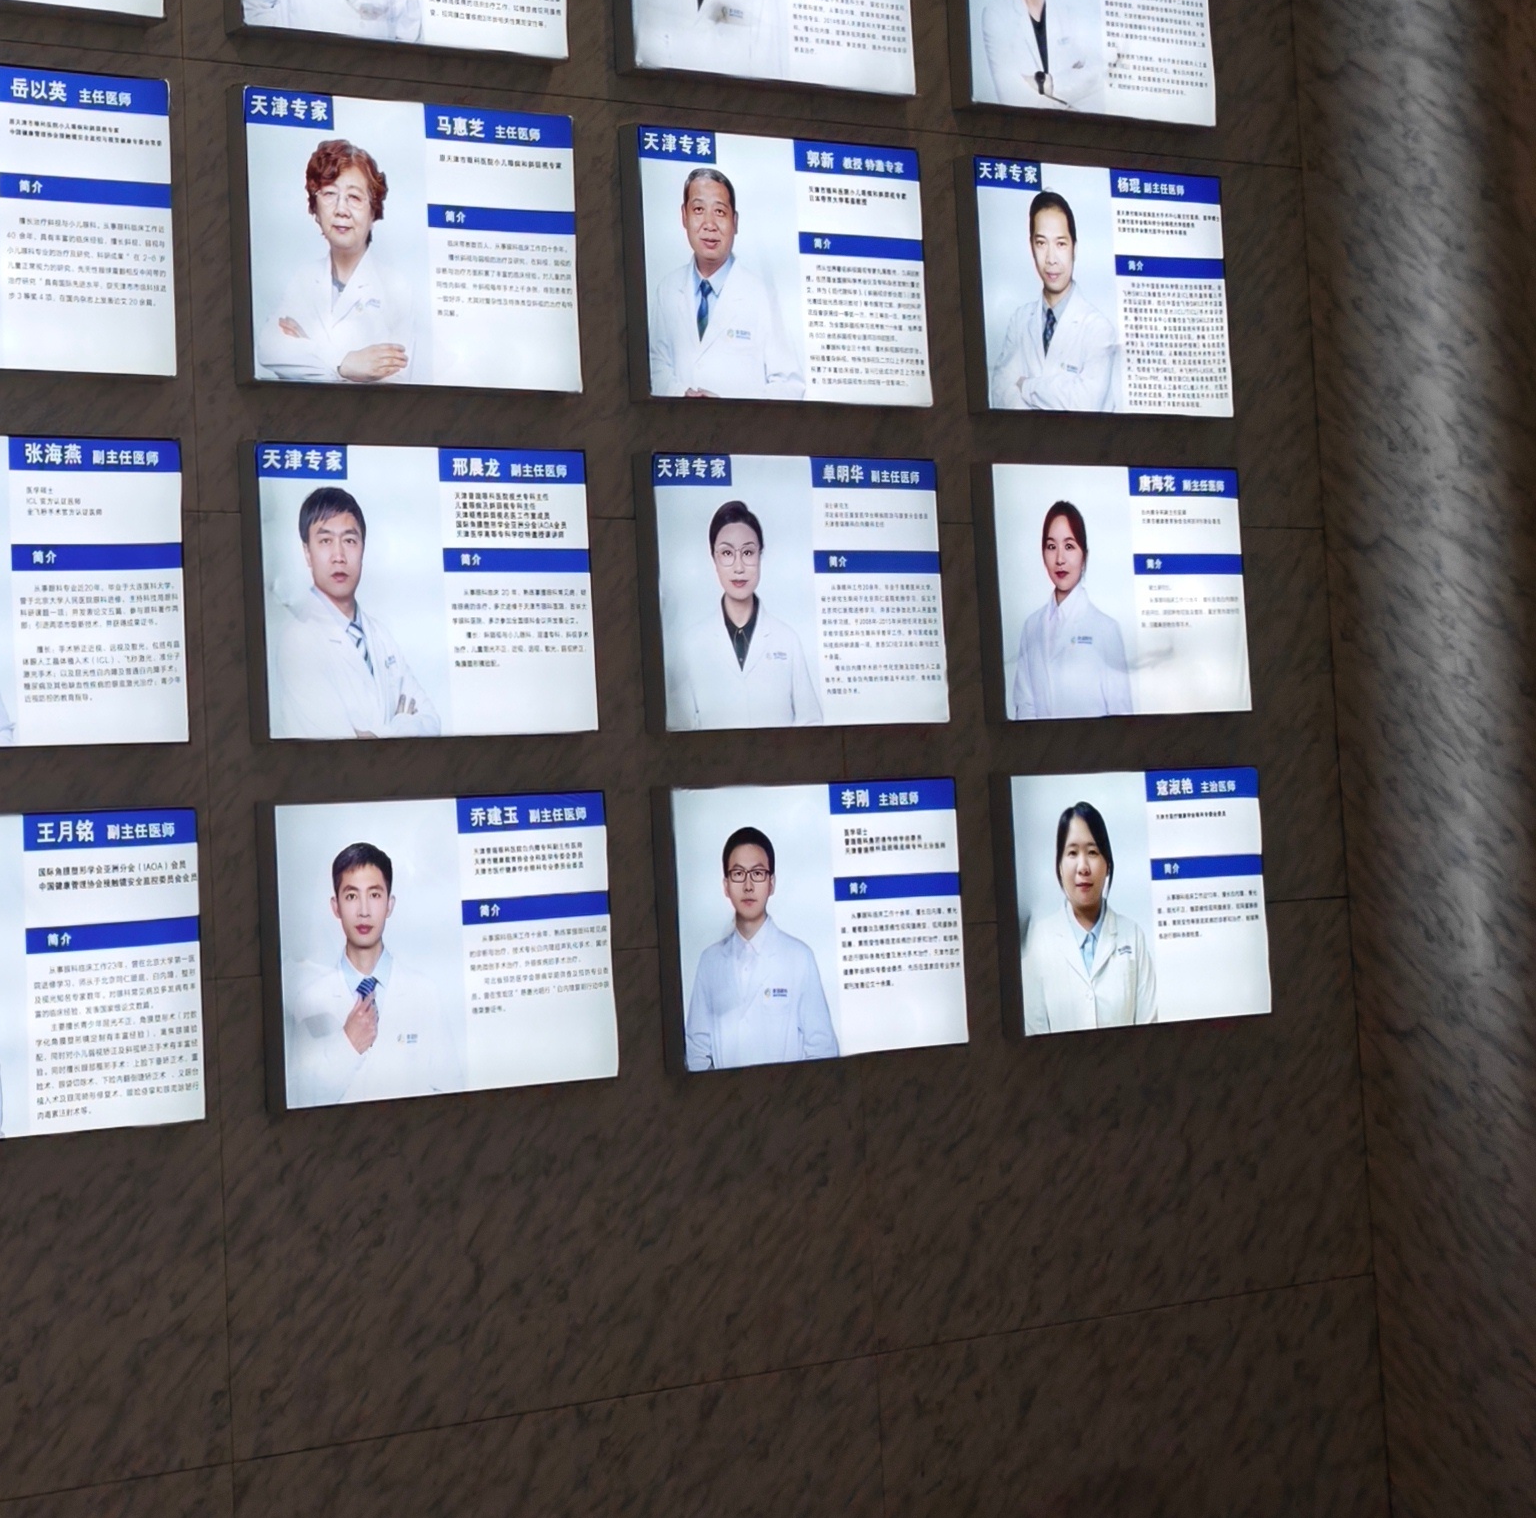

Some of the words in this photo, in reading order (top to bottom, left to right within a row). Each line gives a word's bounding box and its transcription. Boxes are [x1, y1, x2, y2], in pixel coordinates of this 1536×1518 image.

[9, 76, 67, 102] 岳以英
[78, 87, 132, 107] 主任医师
[250, 94, 328, 122] 天津专家
[436, 115, 485, 138] 马惠芝
[494, 124, 541, 142] 主任医师
[644, 133, 711, 156] 天津专家
[805, 149, 834, 169] 郭新
[842, 156, 863, 171] 教授
[979, 163, 1037, 184] 天津专家
[18, 178, 43, 194] 简介
[1143, 181, 1185, 196] 副主任医师
[444, 209, 466, 224] 简介
[813, 237, 831, 249] 简介
[1127, 259, 1144, 271] 简介
[24, 441, 82, 465] 张海燕
[91, 448, 159, 466] 副主任医师
[262, 449, 342, 472] 天津专家
[451, 457, 501, 477] 邢晨龙
[509, 463, 567, 478] 副主任医师
[658, 458, 726, 478] 天津专家
[821, 464, 865, 484] 单明华
[870, 469, 920, 484] 副主任医师
[31, 549, 57, 564] 简介
[460, 552, 482, 566] 简介
[828, 555, 847, 568] 简介
[1145, 558, 1162, 569] 简介
[1200, 779, 1236, 793] 主治医师
[840, 788, 870, 809] 李刚
[878, 790, 919, 807] 主治医师
[469, 805, 520, 827] 乔建玉
[528, 806, 587, 824] 副主任医师
[36, 818, 95, 843] 王月铭
[106, 821, 175, 840] 副主任医师
[1163, 862, 1180, 874] 简介
[848, 881, 868, 894] 简介
[478, 903, 501, 917] 简介
[46, 931, 72, 947] 简介
